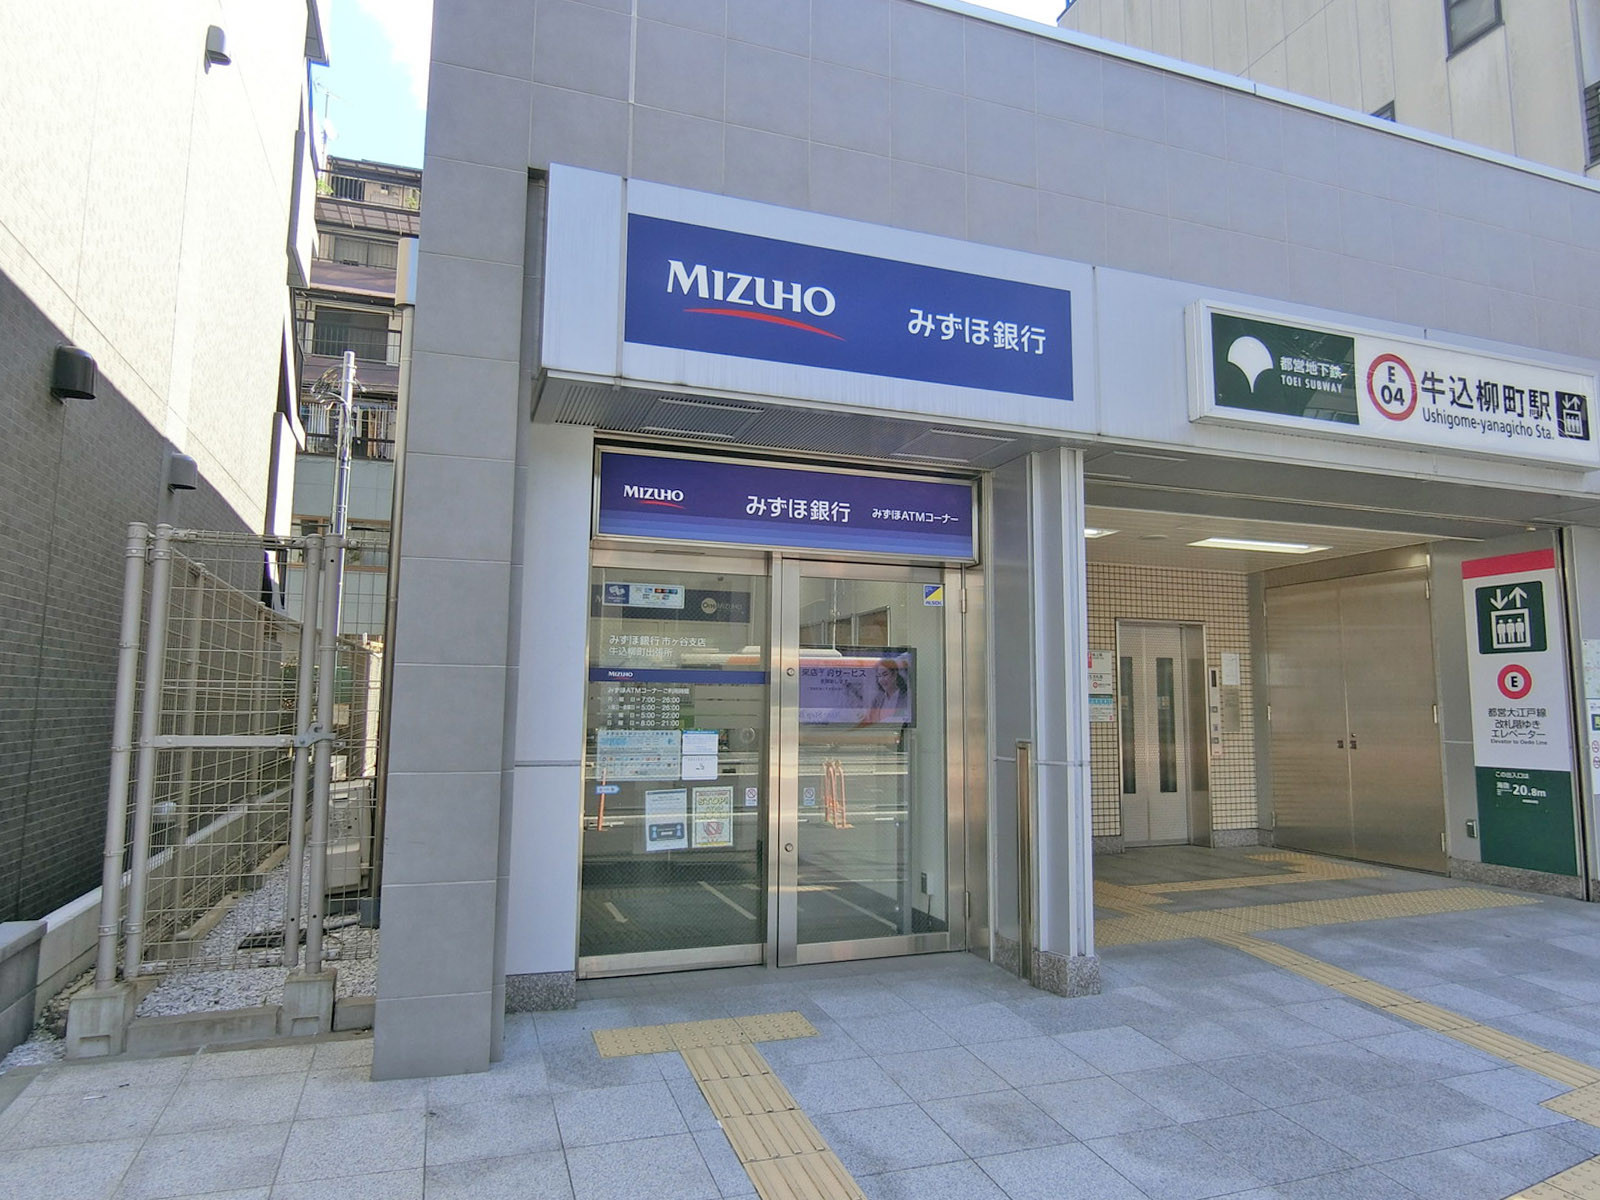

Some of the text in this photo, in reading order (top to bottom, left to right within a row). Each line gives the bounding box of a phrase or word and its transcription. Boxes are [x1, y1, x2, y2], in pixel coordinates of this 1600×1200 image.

[667, 259, 837, 317] MIZUHO
[908, 308, 1046, 355] みずほ銀行
[1279, 355, 1343, 380] 都営地下鉄
[1388, 365, 1396, 383] E
[1280, 374, 1343, 394] TOEI SUBWAY
[1381, 387, 1405, 407] 04
[1421, 370, 1551, 422] 牛込柳町駅
[1422, 407, 1555, 440] Ushigome-yanagicho Sta.
[623, 484, 684, 502] MIZUHO
[745, 495, 959, 525] みずほ銀行 みずほATMコーナー
[609, 635, 661, 645] みずほ銀行
[608, 670, 634, 678] MIZUHO
[1511, 676, 1519, 688] E
[1488, 707, 1547, 718] 都営大江戸線
[1491, 729, 1546, 739] エレベーター
[1512, 784, 1547, 798] 20.8m
